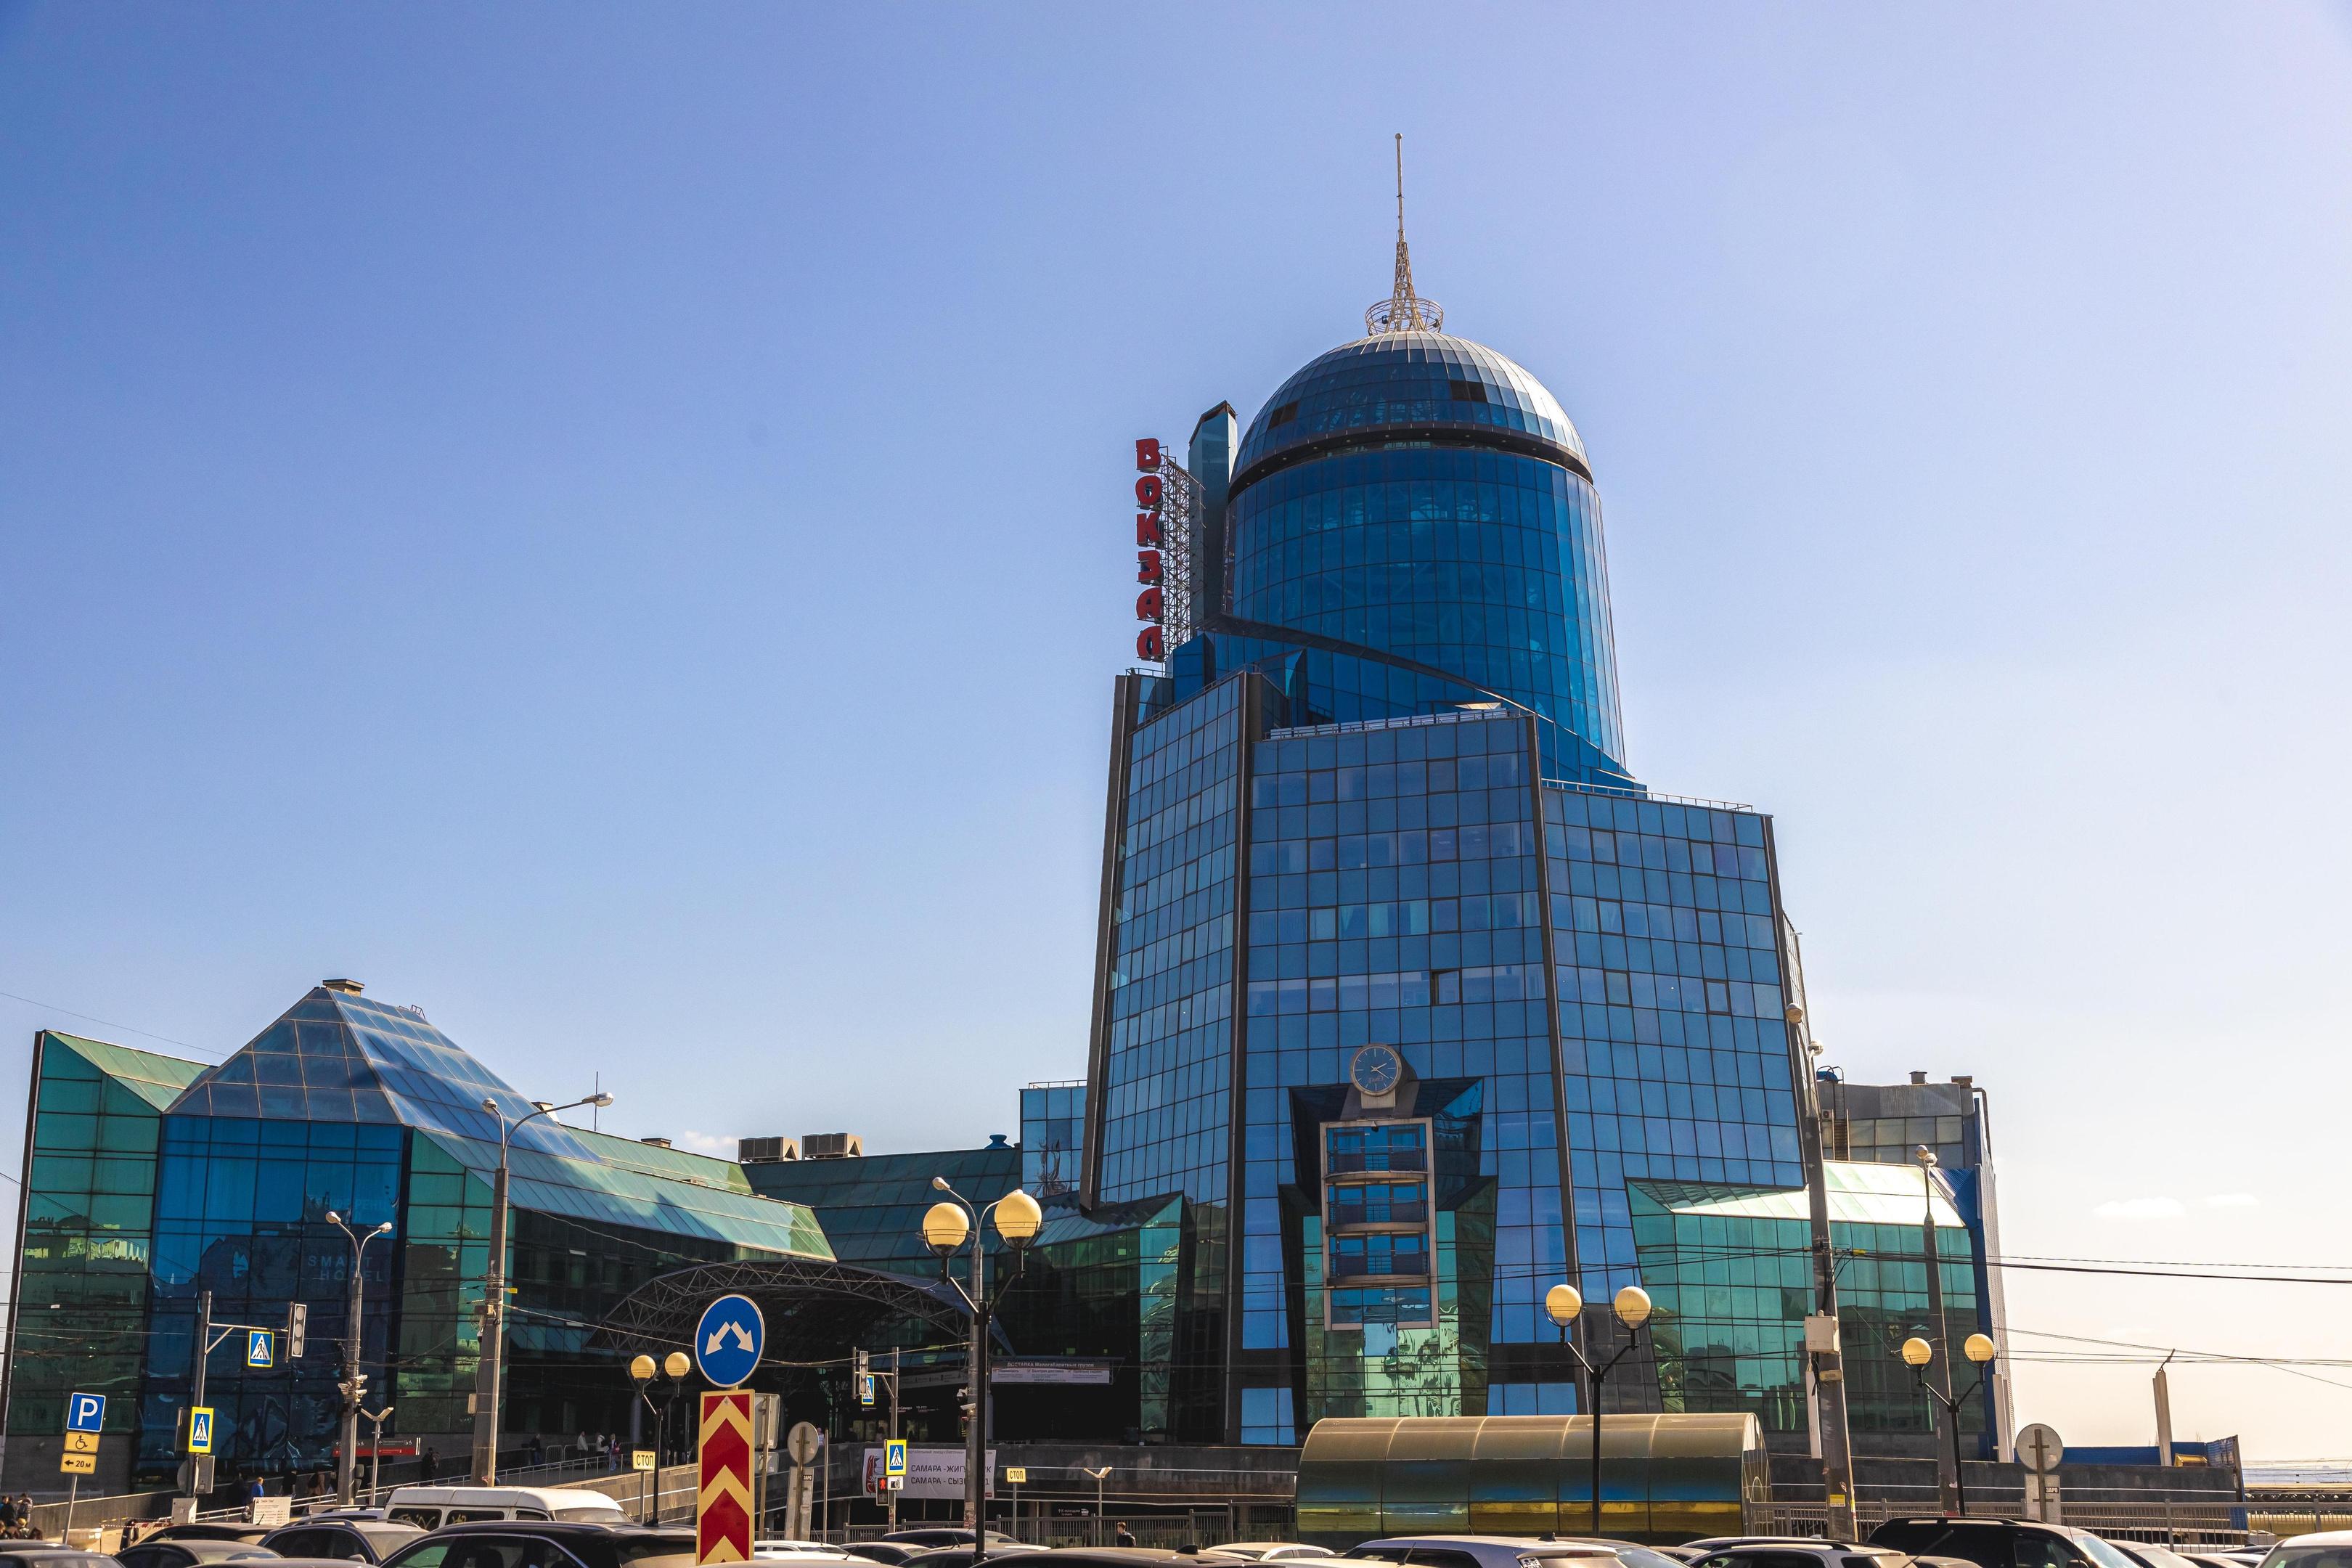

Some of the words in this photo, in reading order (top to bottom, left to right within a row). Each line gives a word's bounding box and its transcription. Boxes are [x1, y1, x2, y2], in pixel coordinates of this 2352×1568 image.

[1135, 438, 1161, 658] ВОКЗАЛ
[320, 1270, 384, 1282] HOEL
[636, 1454, 653, 1466] СТОП
[1009, 1470, 1024, 1479] СТОП
